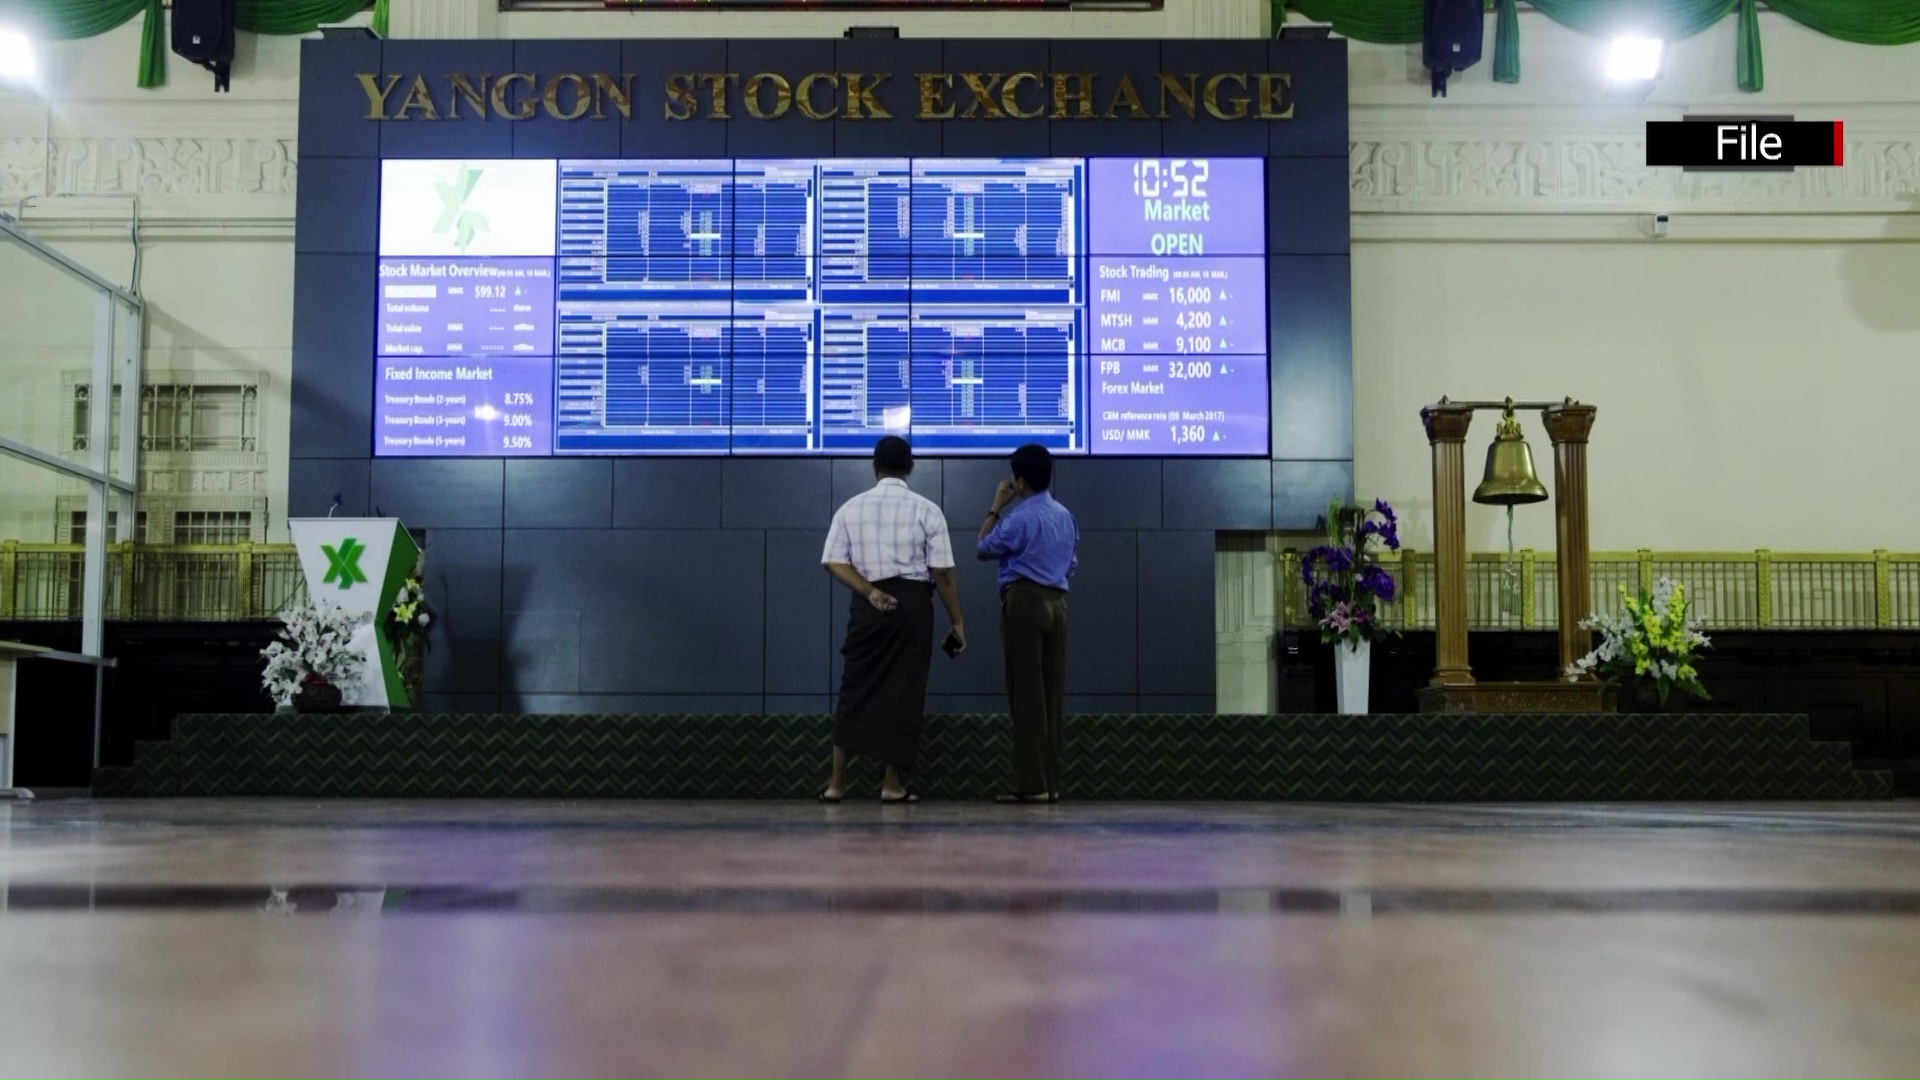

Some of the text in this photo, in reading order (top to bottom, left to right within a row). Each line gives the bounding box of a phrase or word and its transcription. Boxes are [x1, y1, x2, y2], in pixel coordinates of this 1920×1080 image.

[355, 72, 1295, 121] YANGON STOCK EXCHANGE
[1133, 159, 1209, 198] 10:52
[1144, 199, 1210, 221] Market
[1151, 233, 1203, 256] OPEN
[379, 264, 407, 277] Stock
[410, 264, 447, 277] Market
[449, 264, 498, 277] Overview
[1099, 265, 1127, 279] Stock
[1130, 265, 1169, 281] Trading
[475, 285, 506, 298] 599.12
[1100, 290, 1120, 302] FMI
[1169, 287, 1211, 306] 16,000
[386, 304, 403, 312] Total
[1101, 314, 1132, 326] MTSH
[1176, 312, 1211, 330] 4,200
[386, 324, 403, 333] Total
[385, 344, 410, 353] Market
[1101, 339, 1126, 351] MCB
[1176, 336, 1211, 354] 9,100
[385, 367, 492, 380] Fixed Income Market
[1100, 362, 1120, 374] FPB
[1168, 362, 1211, 380] 32,000
[1102, 382, 1164, 394] Forex Market
[384, 393, 533, 406] Treasury Bonds (2-years) 8.75%
[384, 415, 412, 426] Treasury
[414, 415, 435, 424] Bonds
[504, 414, 532, 426] 9.00%
[1103, 412, 1119, 420] CBM
[1120, 412, 1152, 420] reference
[1153, 412, 1167, 420] rate
[1182, 412, 1204, 420] March
[1205, 411, 1224, 422] 2017)
[1102, 426, 1205, 444] USD/ MMK 1,360
[384, 436, 532, 448] Treasury Bonds (5-years) 9.50%
